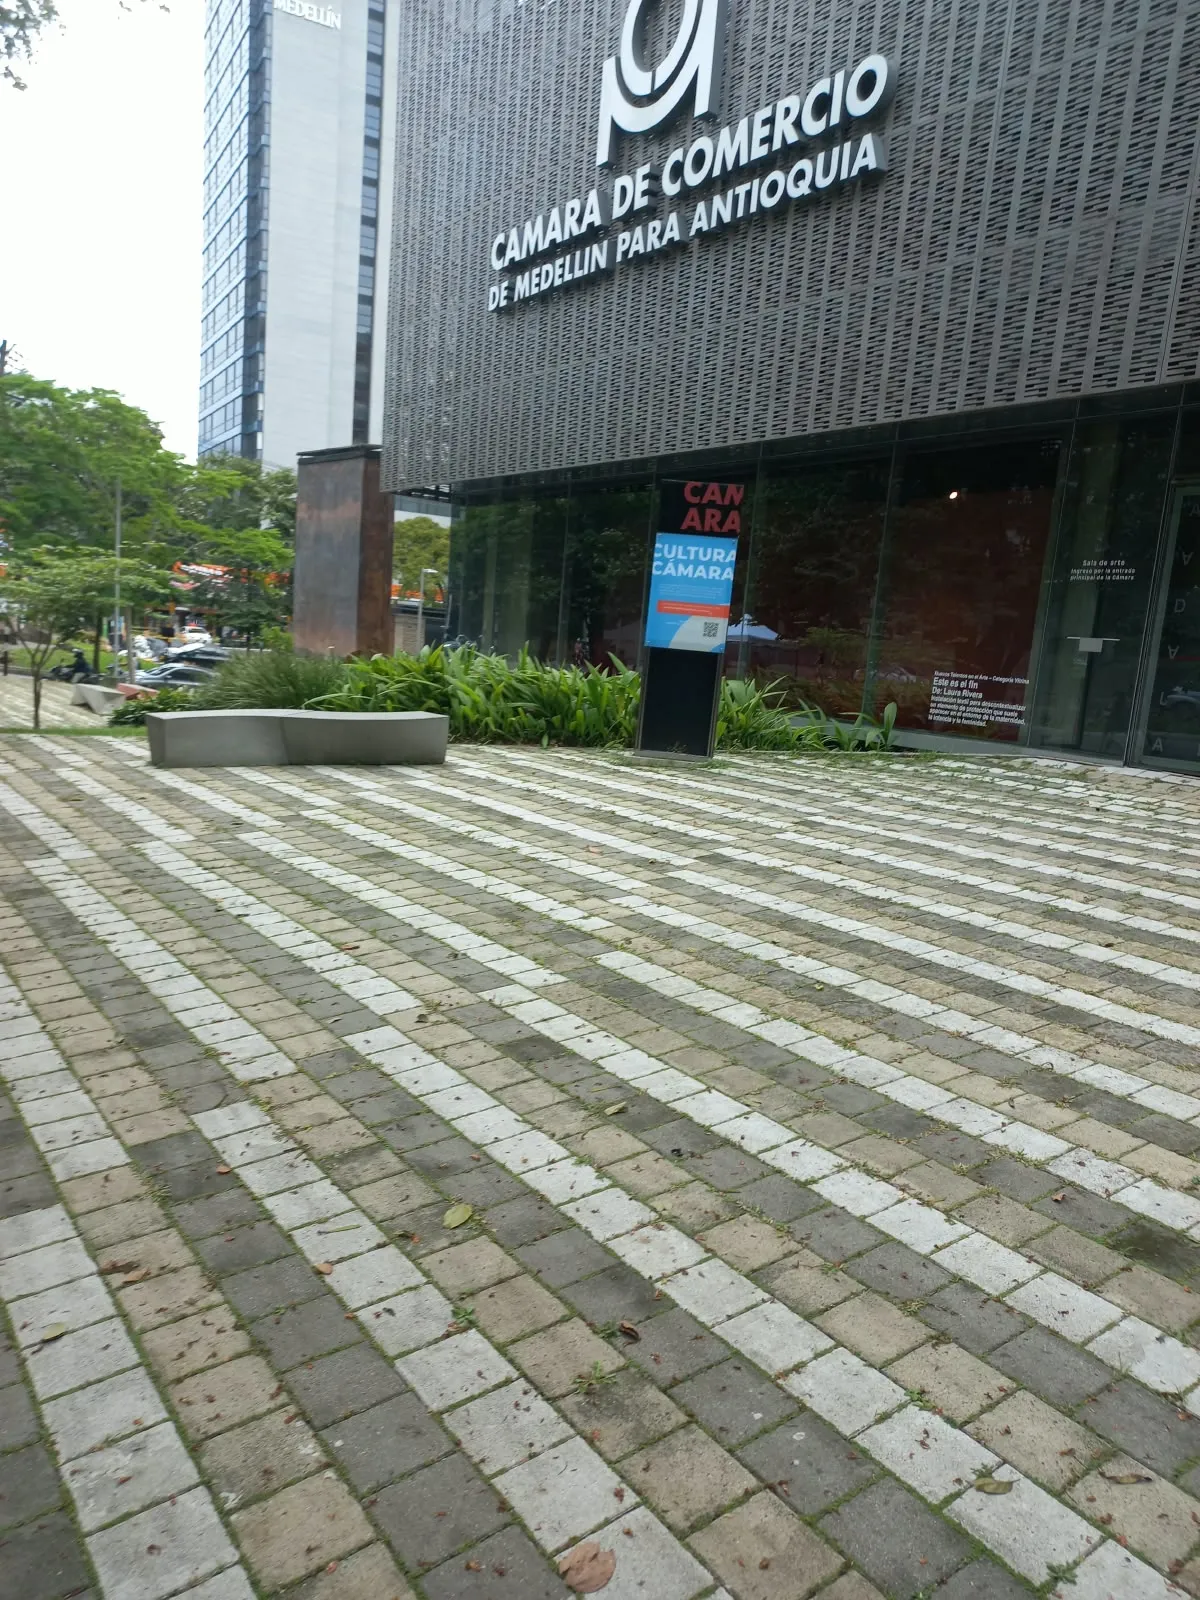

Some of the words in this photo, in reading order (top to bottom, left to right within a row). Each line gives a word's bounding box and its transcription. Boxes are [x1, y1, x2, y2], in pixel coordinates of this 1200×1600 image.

[490, 189, 603, 271] CAMARA
[611, 162, 653, 220] DE
[661, 54, 888, 196] COMERCIO
[487, 281, 508, 311] DE
[513, 241, 608, 302] MEDELLIN
[615, 212, 680, 263] PARA
[689, 133, 877, 236] ANTIOQUIA
[654, 543, 737, 564] CULTURA
[652, 558, 734, 581] CÁMARA
[933, 677, 948, 687] Este
[949, 679, 959, 687] es
[960, 679, 967, 688] el
[968, 680, 979, 689] fin
[943, 687, 961, 696] Laura
[962, 689, 983, 699] Rivera
